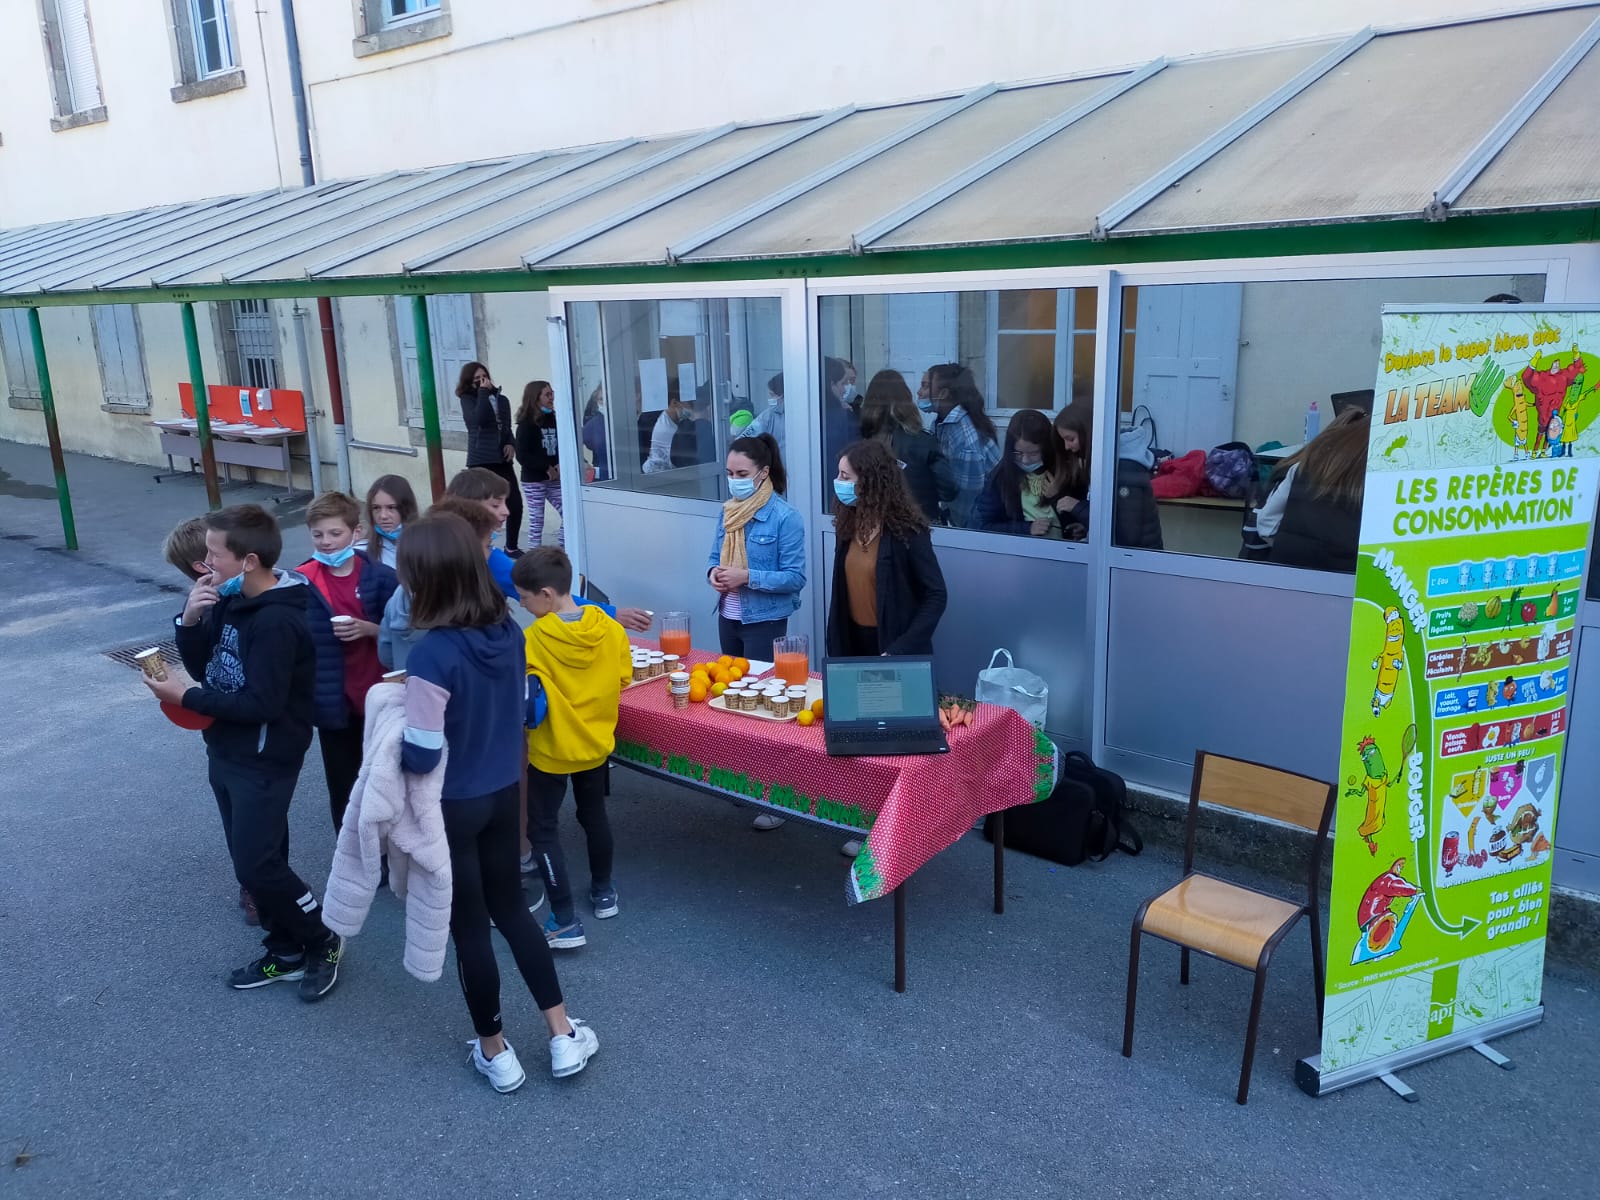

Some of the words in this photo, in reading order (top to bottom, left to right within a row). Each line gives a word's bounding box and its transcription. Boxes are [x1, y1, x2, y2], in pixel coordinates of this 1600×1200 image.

[1384, 349, 1435, 373] Deviens
[1439, 343, 1452, 363] le
[1455, 340, 1491, 362] super
[1532, 327, 1561, 347] avec
[1384, 386, 1411, 425] LA
[1414, 372, 1478, 420] TEAM
[1395, 477, 1438, 505] LES
[1447, 465, 1543, 500] REPÈRES
[1552, 466, 1579, 493] DE
[1393, 495, 1574, 536] CONSOMMATION
[1373, 547, 1428, 634] MANGER
[1408, 751, 1426, 842] BOUGER
[1486, 907, 1514, 925] pour
[1518, 898, 1542, 914] bien
[1490, 891, 1509, 904] Tes
[1513, 881, 1543, 900] alliés
[1486, 917, 1531, 941] grandir
[1429, 997, 1455, 1025] api
